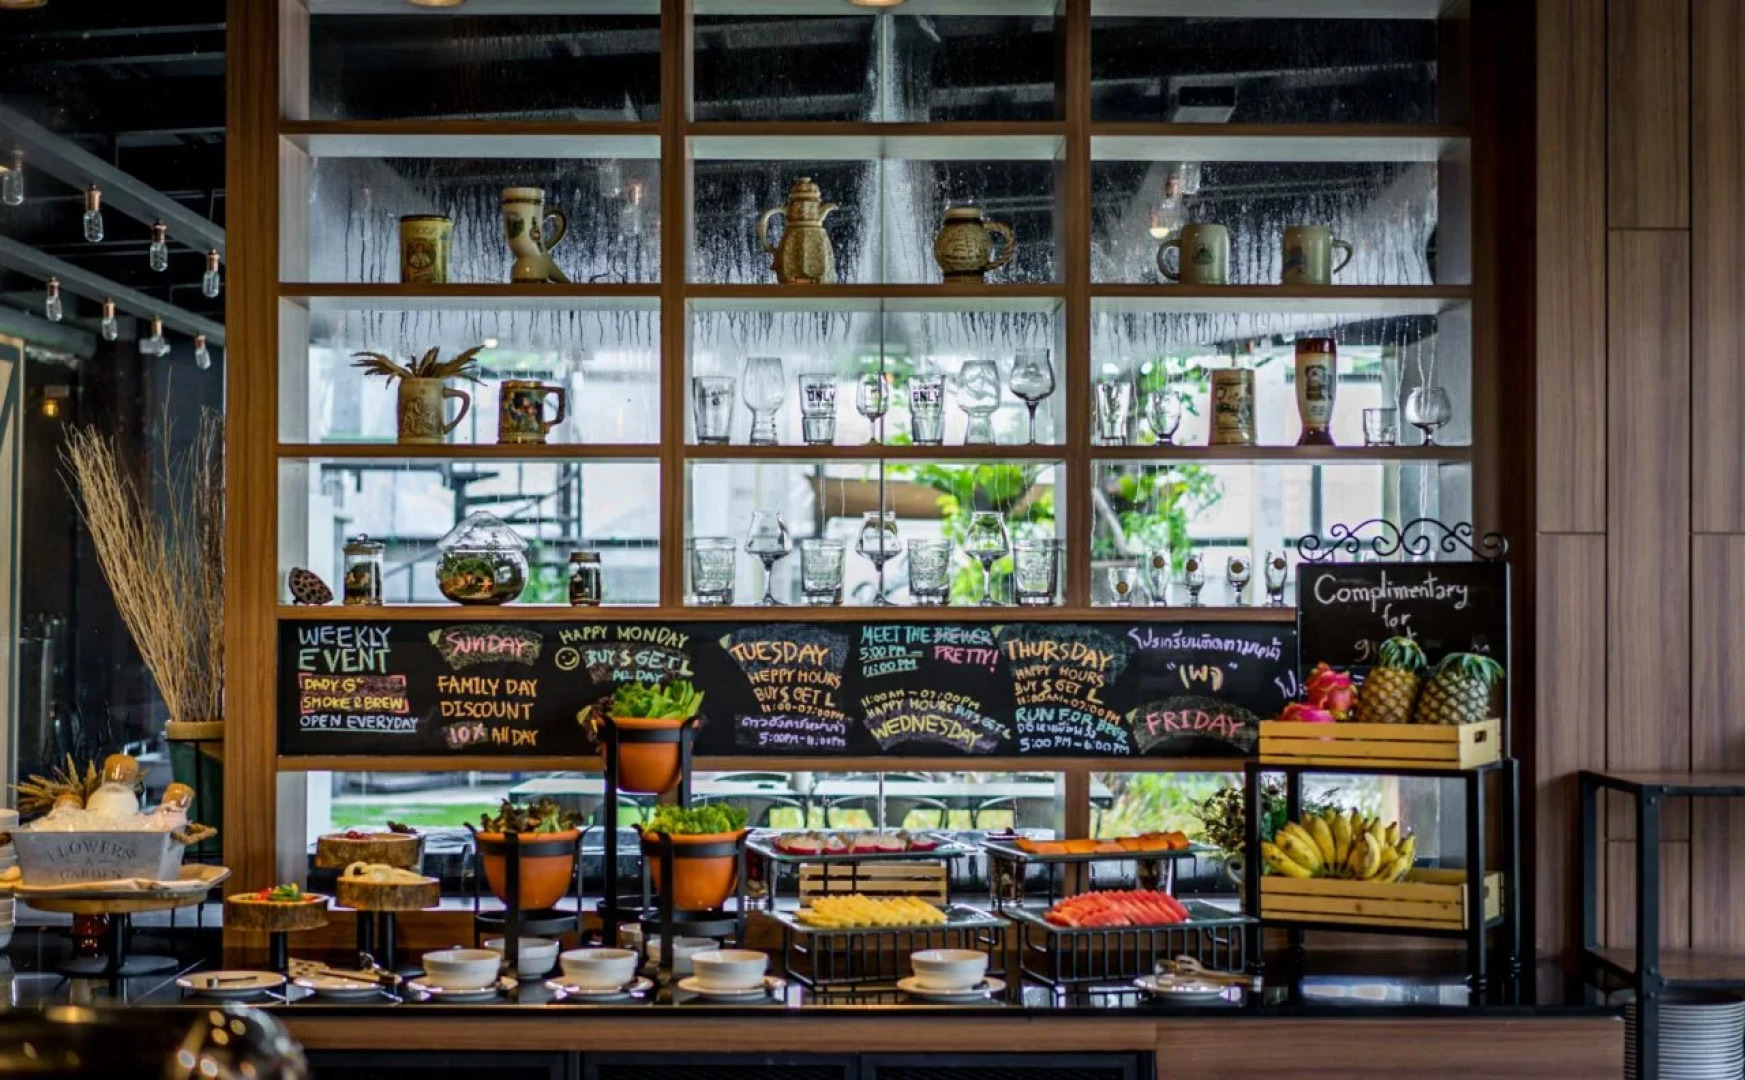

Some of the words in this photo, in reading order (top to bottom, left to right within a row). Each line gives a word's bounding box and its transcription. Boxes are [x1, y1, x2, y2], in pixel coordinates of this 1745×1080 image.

[1313, 570, 1468, 613] Complimentary
[1381, 603, 1412, 627] for
[298, 625, 391, 648] WEEKLY
[445, 631, 525, 656] SUNDAY
[558, 625, 608, 644] HAPPY
[617, 625, 690, 649] MONDAY
[860, 625, 901, 645] MEET
[903, 625, 932, 644] THE
[298, 647, 391, 673] EVENT
[585, 648, 616, 668] BUY
[635, 650, 680, 668] GET
[729, 641, 830, 667] TUESDAY
[934, 645, 999, 673] PRETTY!
[1004, 638, 1115, 671] THURSDAY
[437, 675, 500, 697] FAMILY
[505, 678, 538, 697] DAY
[635, 670, 665, 683] DAY
[797, 669, 843, 690] HOURS
[1014, 664, 1052, 681] HAPPY
[1059, 666, 1104, 688] HOURS
[792, 687, 822, 705] GET
[1014, 681, 1037, 696] BUY
[1055, 679, 1083, 695] GET
[363, 696, 403, 710] BREW
[440, 700, 534, 720] DISCOUNT
[866, 699, 903, 719] HAPPY
[909, 697, 953, 713] HOURS
[299, 713, 342, 728] OPEN
[347, 714, 418, 730] EVERYDAY
[1015, 707, 1055, 722] RUN
[1059, 708, 1094, 725] FOR
[1145, 708, 1246, 736] FRIDAY
[511, 728, 539, 746] DAY
[870, 713, 984, 748] WEDNESDAY
[44, 839, 137, 862] FLOWERS
[60, 869, 122, 880] GARDEN
